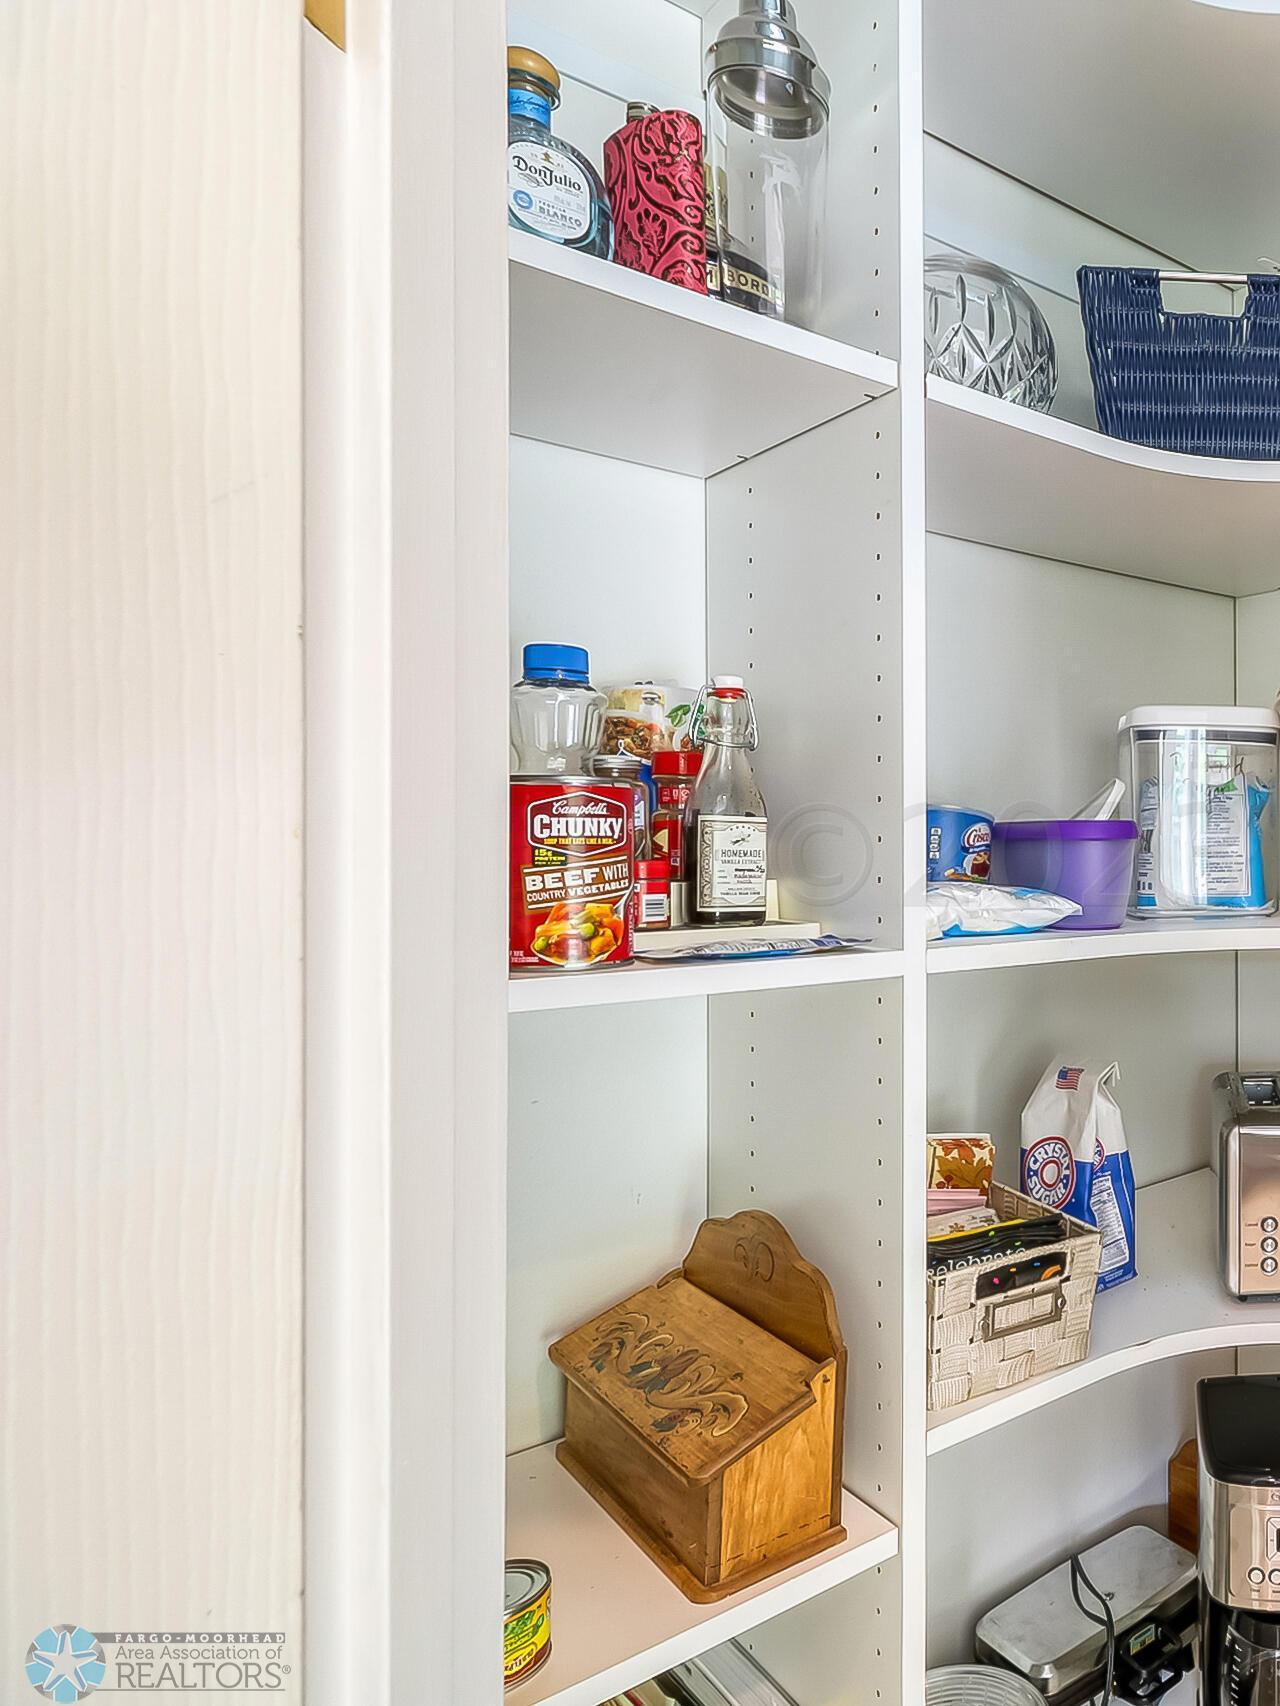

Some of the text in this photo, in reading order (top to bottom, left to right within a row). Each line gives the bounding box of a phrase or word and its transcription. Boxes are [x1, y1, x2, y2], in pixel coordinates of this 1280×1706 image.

[538, 206, 582, 227] BLANCO
[533, 814, 623, 839] CHUNKY
[721, 849, 762, 858] HOMEMADE
[525, 862, 630, 892] BEEF WITH
[526, 878, 629, 902] COUNTRY VEGETABLES
[1029, 1142, 1071, 1179] CRYSTAL
[1028, 1175, 1066, 1205] SUGAR
